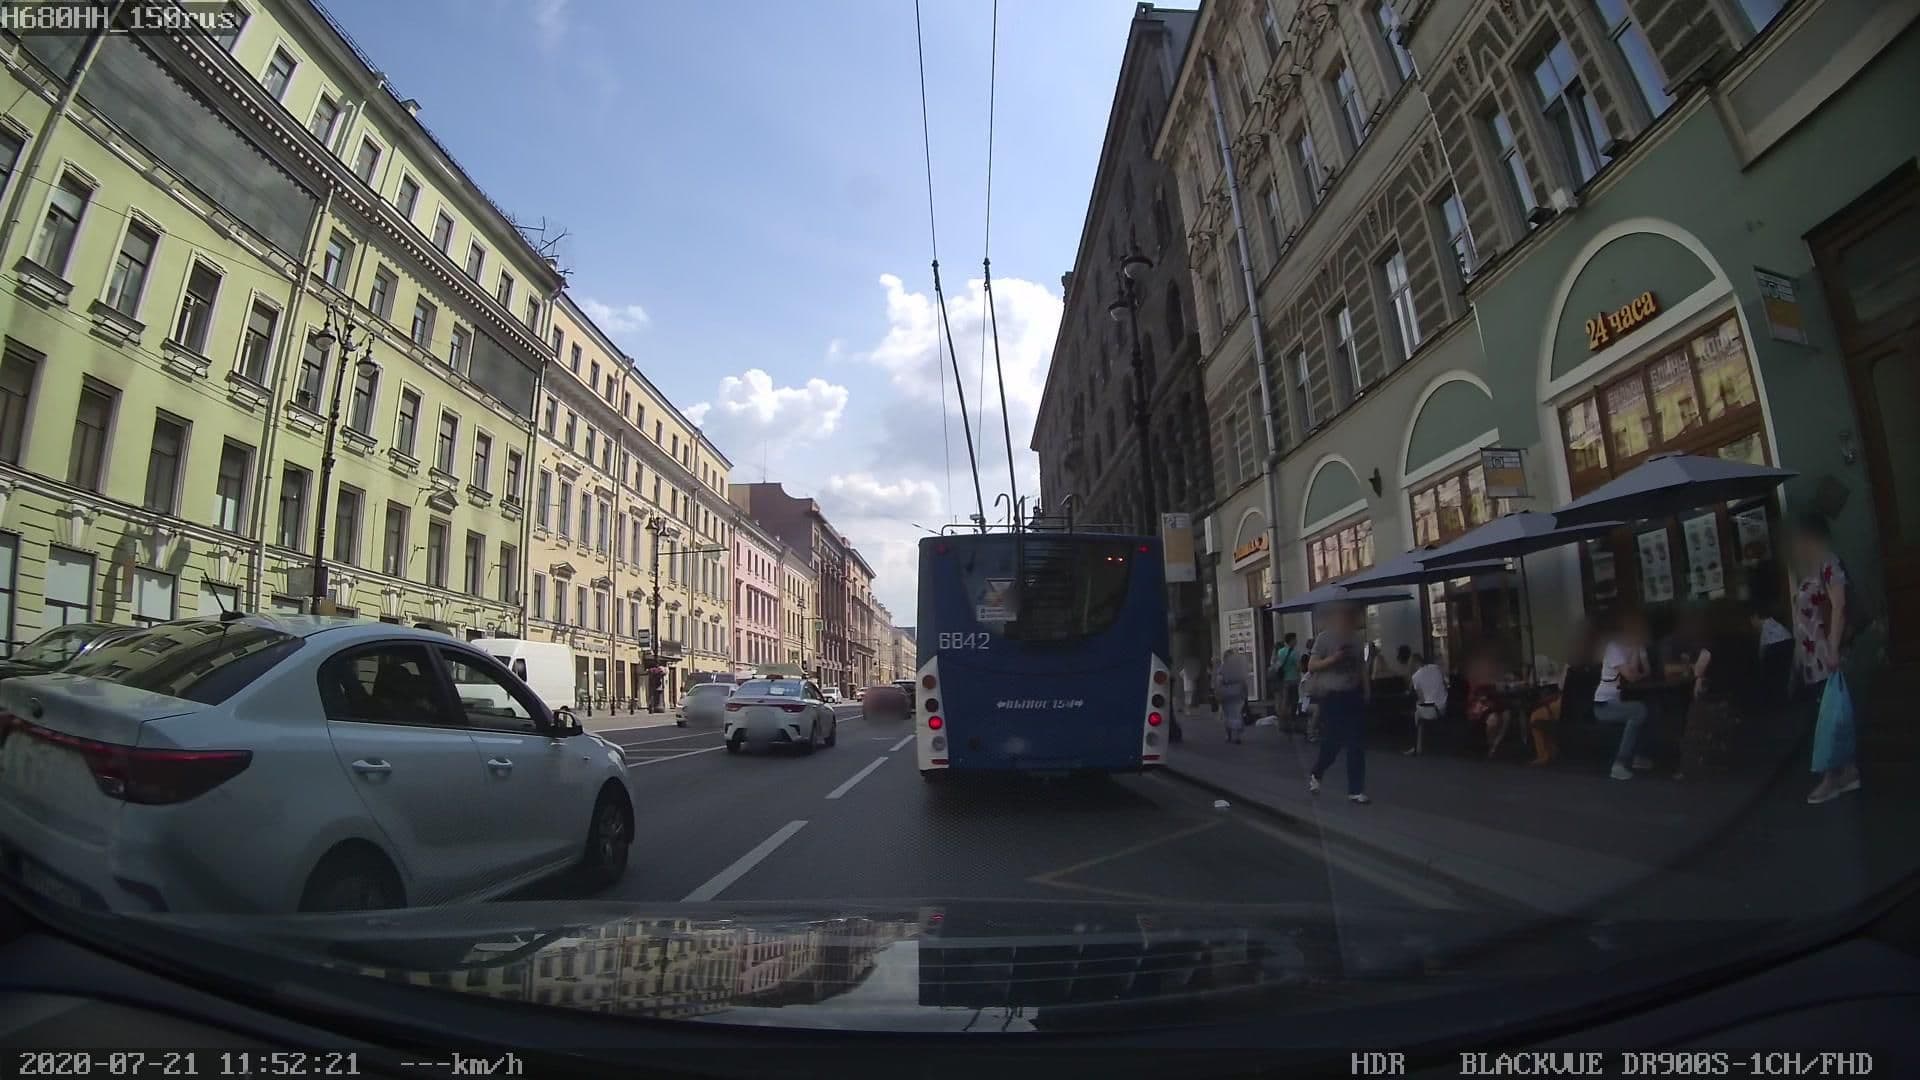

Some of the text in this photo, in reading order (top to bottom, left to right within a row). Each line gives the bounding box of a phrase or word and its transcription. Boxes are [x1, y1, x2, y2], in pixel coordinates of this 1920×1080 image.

[1585, 290, 1657, 351] 24 часа
[939, 632, 991, 650] 6842
